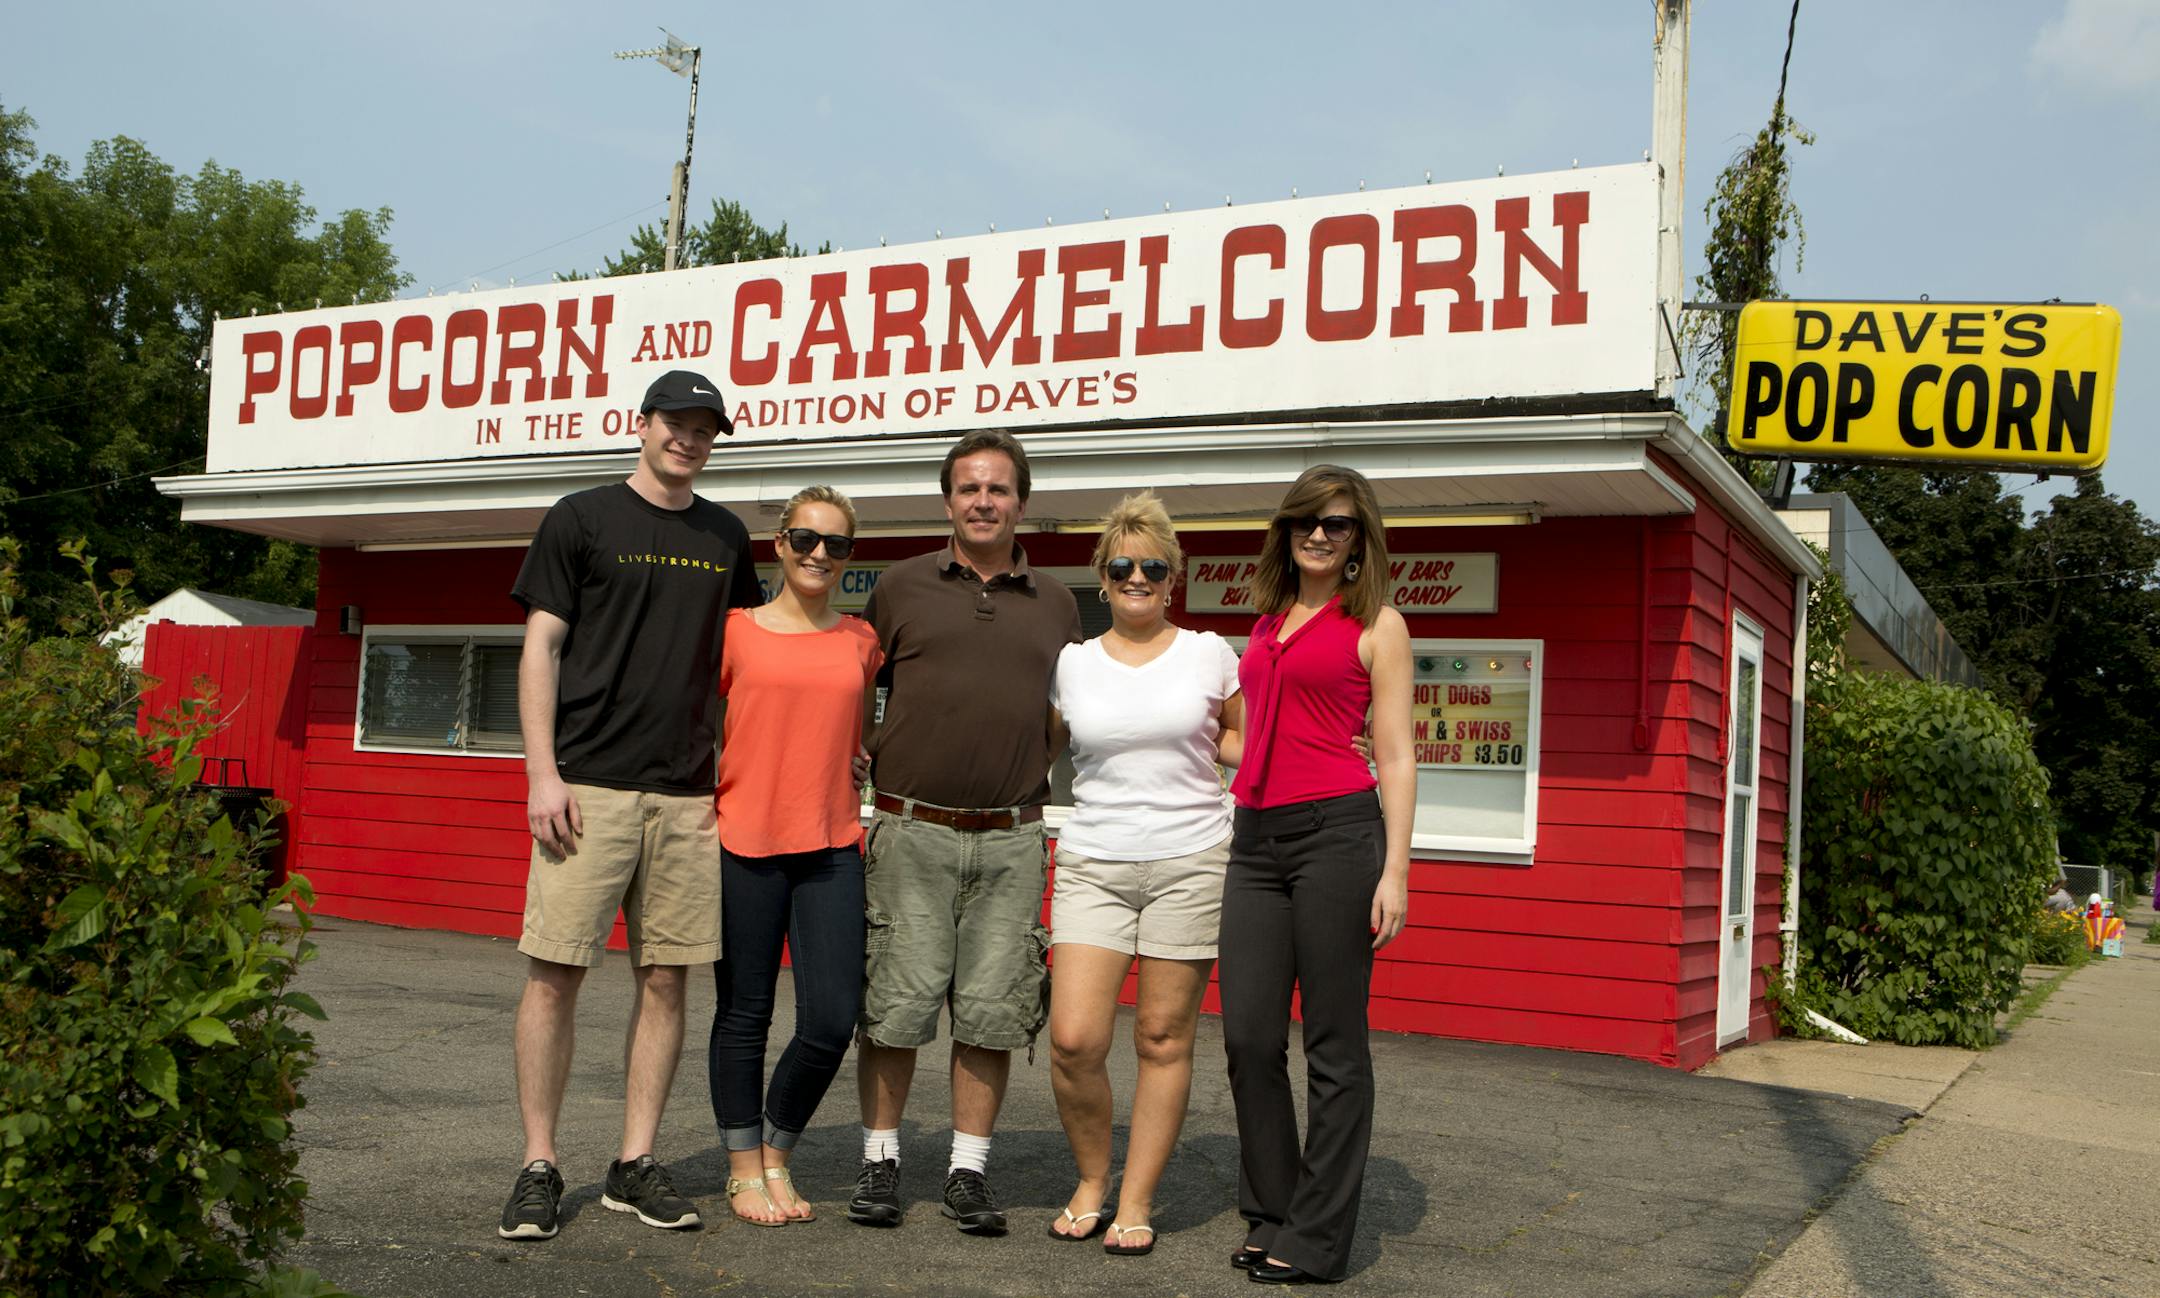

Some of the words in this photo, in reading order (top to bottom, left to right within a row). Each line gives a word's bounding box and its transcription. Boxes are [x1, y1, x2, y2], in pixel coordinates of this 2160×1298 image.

[238, 295, 614, 424] POPCORN
[631, 320, 712, 363] AND
[729, 191, 1590, 386] CARMELCORN
[1794, 309, 2047, 358] DAVE'S
[476, 417, 502, 445] IN
[525, 412, 583, 441] THE
[602, 408, 642, 436] OL
[724, 392, 886, 428] ADITION
[904, 386, 956, 418] OF
[974, 370, 1138, 414] DAVE'S
[1742, 361, 1875, 443] POP
[1899, 363, 2097, 454] CORN
[618, 553, 711, 570] LIVESTRONG
[1194, 563, 1241, 582] PLAIN
[1408, 560, 1455, 582] BARS
[842, 570, 882, 593] CEN
[1393, 585, 1463, 606] CANDY
[1448, 685, 1492, 705] DOGS
[1431, 707, 1442, 718] OR
[1436, 720, 1447, 741] &
[1455, 721, 1512, 741] SWISS
[1415, 743, 1462, 763] CHIPS
[1474, 744, 1523, 764] $3.50
